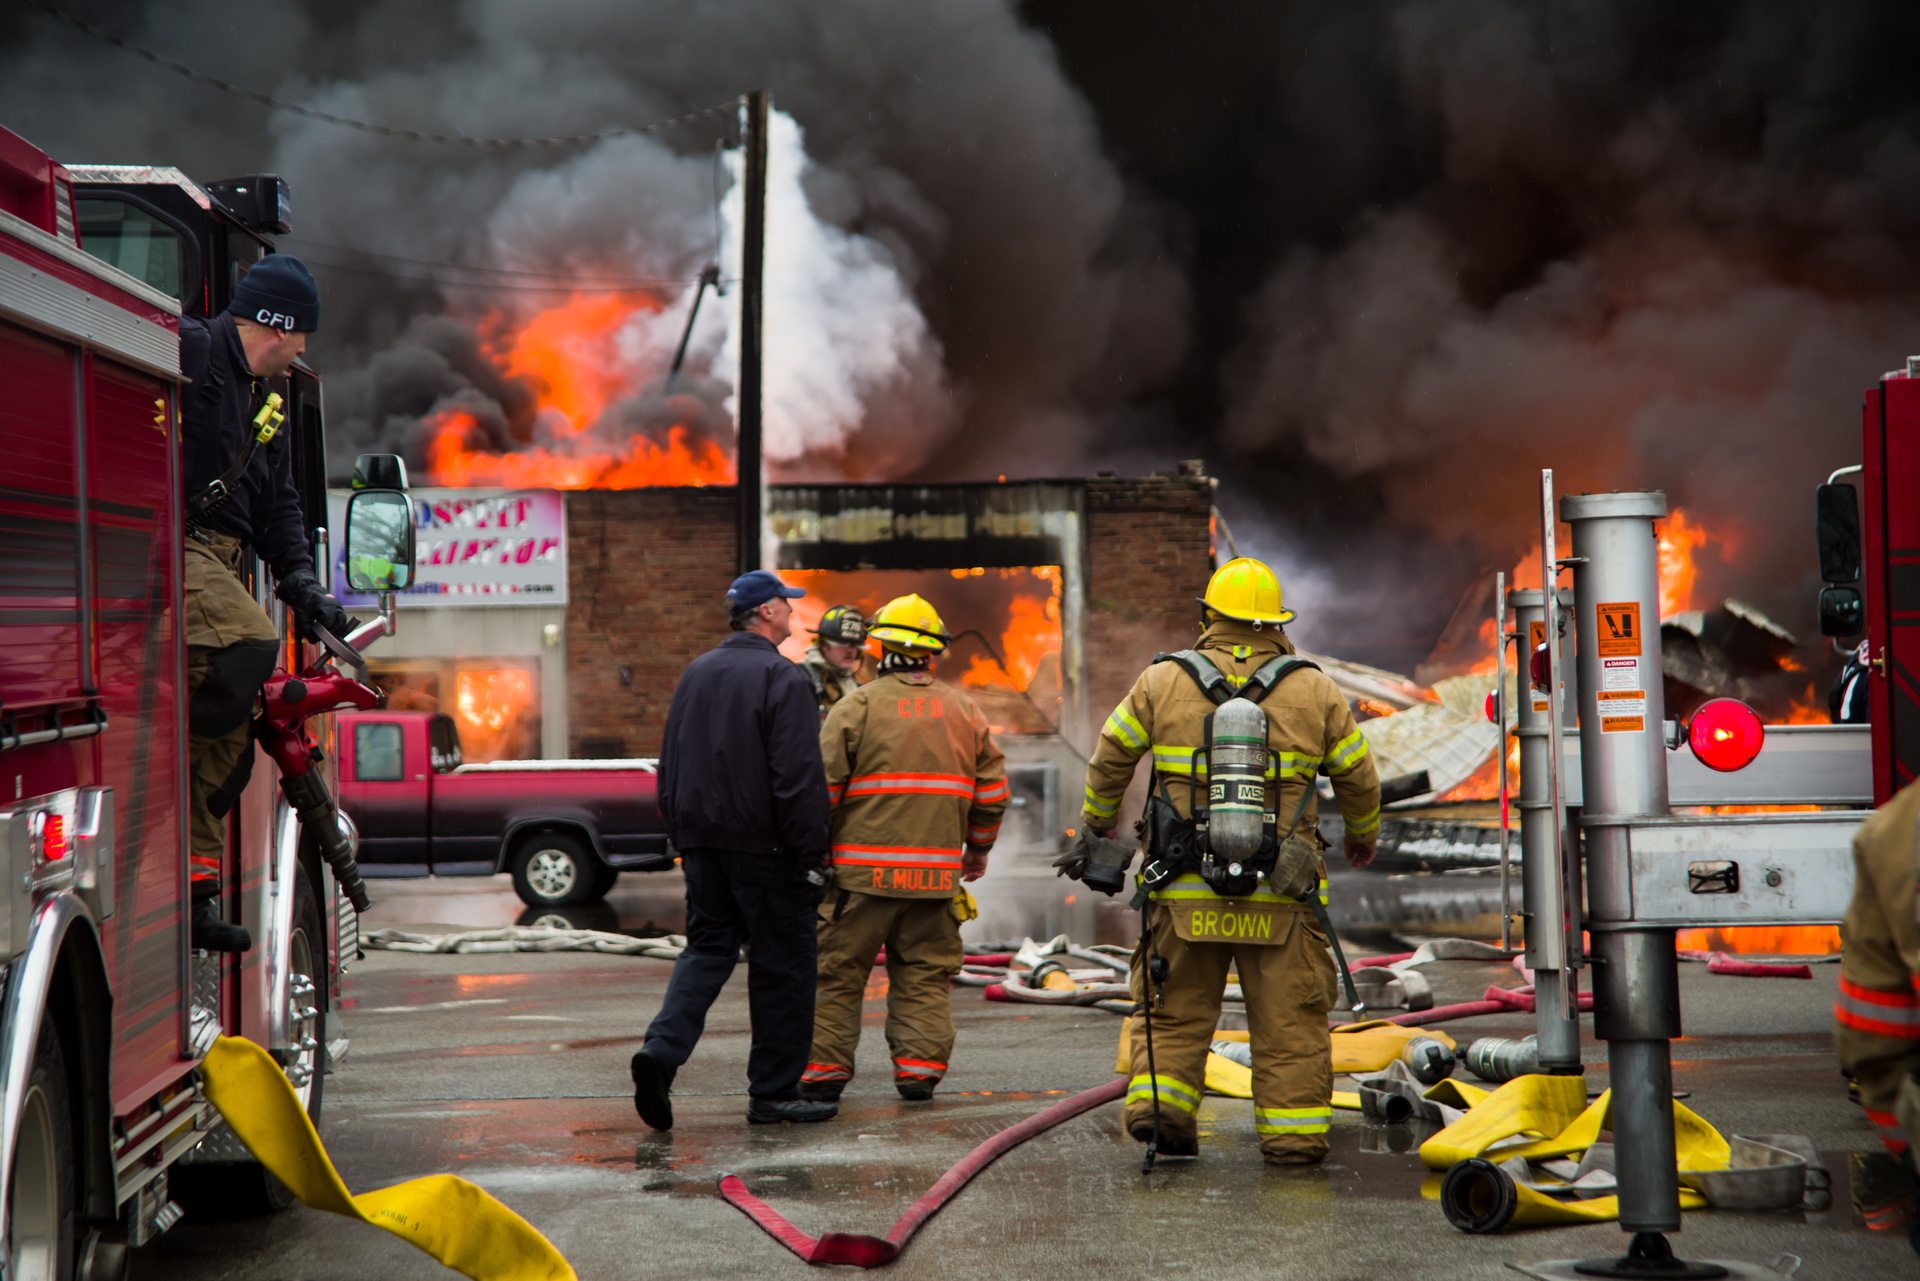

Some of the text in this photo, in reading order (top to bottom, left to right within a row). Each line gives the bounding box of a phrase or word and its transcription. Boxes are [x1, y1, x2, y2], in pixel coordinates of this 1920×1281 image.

[256, 308, 295, 330] CFD
[414, 498, 532, 529] OSSFIT
[416, 536, 560, 566] ALIATION
[898, 697, 943, 718] CFD
[872, 867, 953, 891] R. MULLIS
[1191, 910, 1272, 939] BROWN
